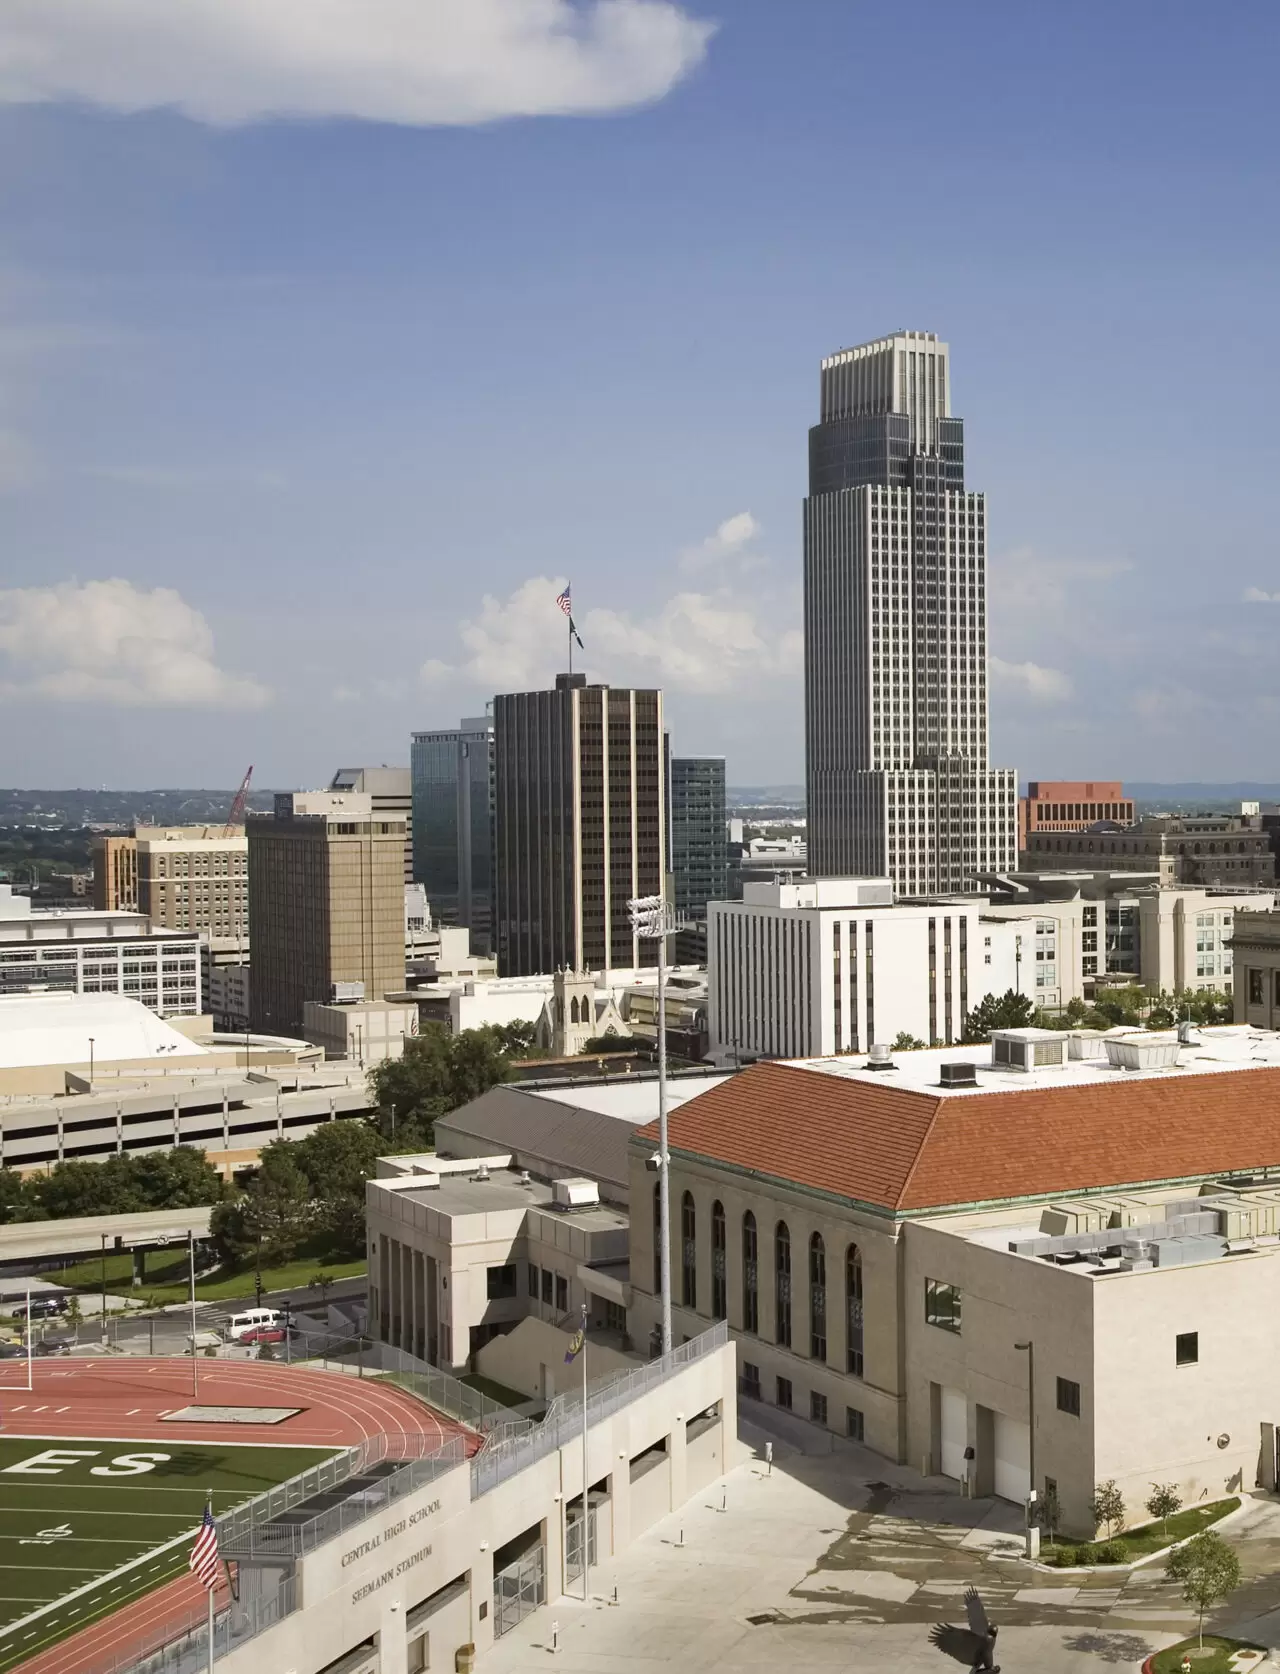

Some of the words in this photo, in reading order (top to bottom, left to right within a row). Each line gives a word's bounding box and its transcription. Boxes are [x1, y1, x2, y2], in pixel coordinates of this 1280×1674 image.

[341, 1535, 381, 1568] CENTRAL
[384, 1519, 406, 1542] HIGH
[408, 1499, 442, 1527] SCHOOL
[352, 1568, 394, 1605] SEEMANN
[396, 1544, 433, 1576] STADIUM
